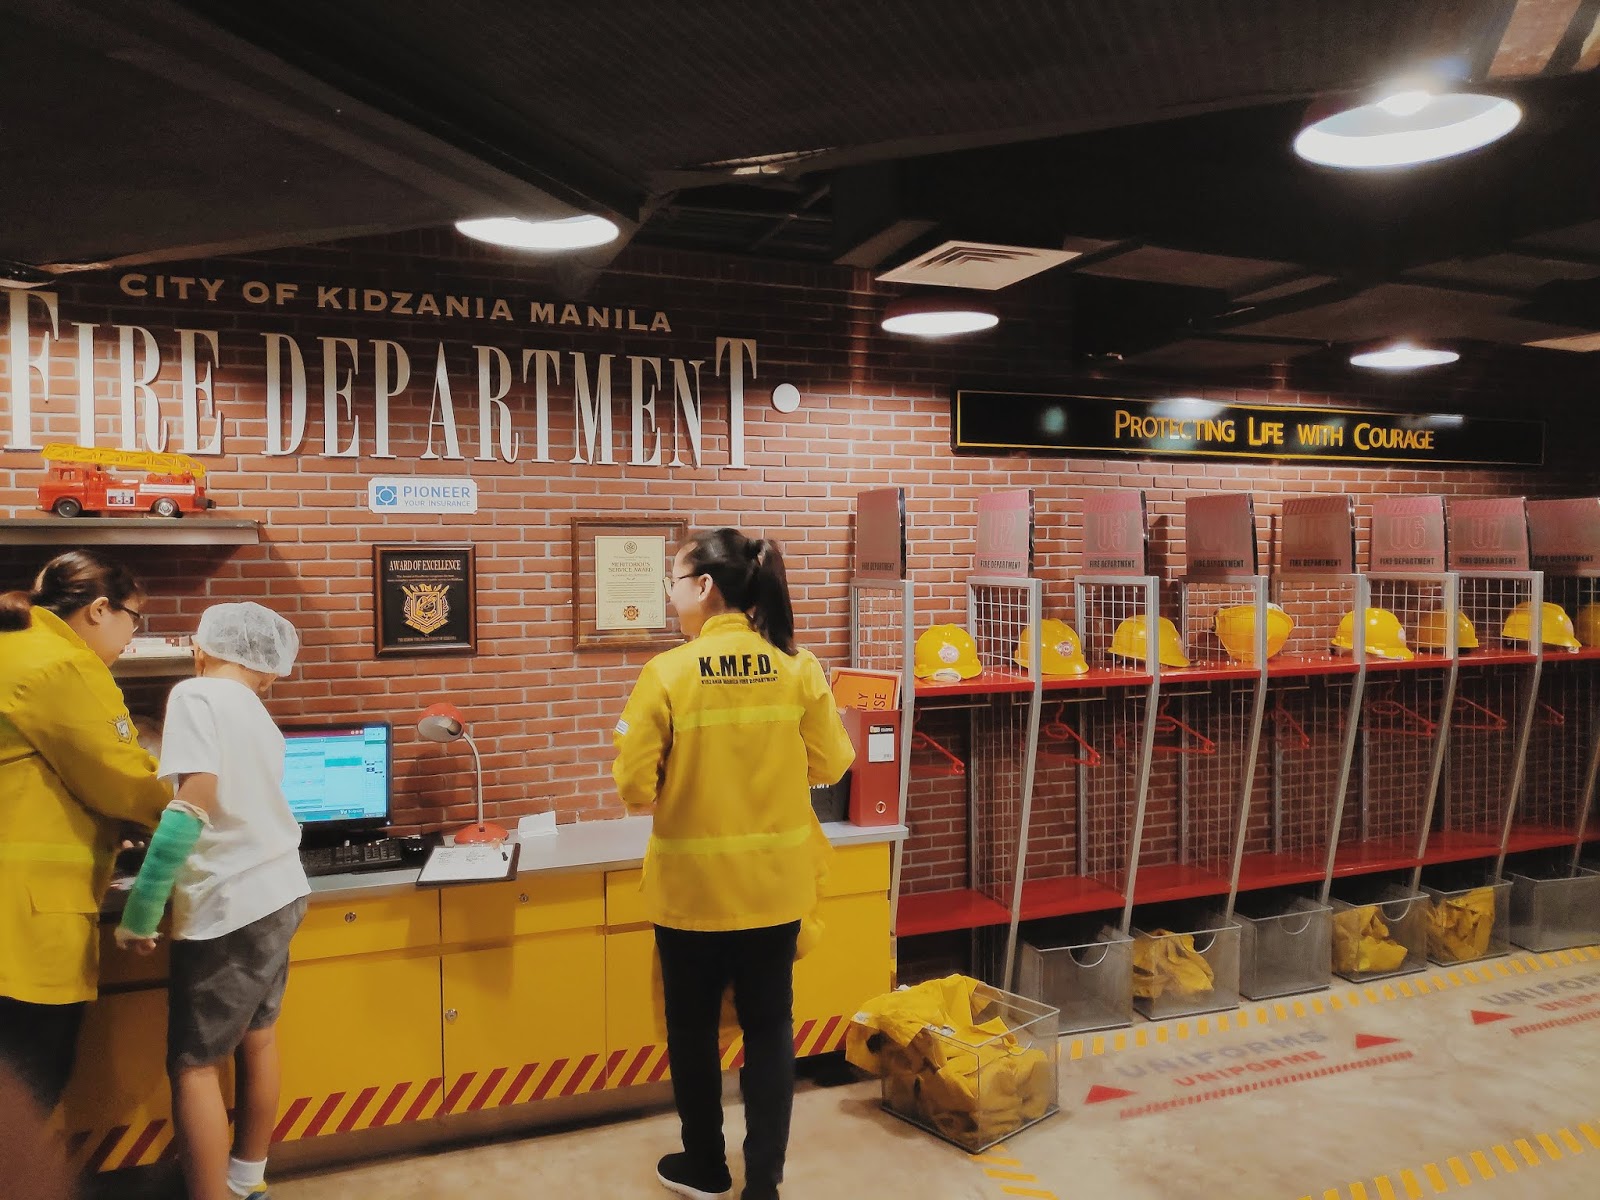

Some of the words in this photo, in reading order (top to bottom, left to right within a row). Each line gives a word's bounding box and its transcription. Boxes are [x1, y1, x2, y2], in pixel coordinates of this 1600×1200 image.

[119, 272, 229, 302] CITY
[242, 281, 300, 306] OF
[317, 286, 514, 321] KIDZANIA
[530, 302, 672, 333] MANILA
[0, 288, 224, 456] FIRE
[260, 332, 757, 470] DEPARTMENT
[1115, 410, 1236, 443] PROTECTING
[1249, 417, 1284, 446] LIFE
[1354, 422, 1435, 450] COURAGE
[403, 485, 471, 498] PIONEER
[389, 559, 413, 571] AWARD
[413, 559, 422, 571] OF
[422, 559, 462, 571] EXCELLENCE
[980, 560, 990, 570] FIRE
[991, 560, 1021, 570] DEPARTMENT
[1100, 560, 1135, 568] DEPARTMENT
[1303, 559, 1342, 567] DEPARTMENT
[1394, 557, 1435, 566] DEPARTMENT
[698, 653, 778, 677] K.M.F.D.
[1115, 1030, 1329, 1079] UNIFORMS
